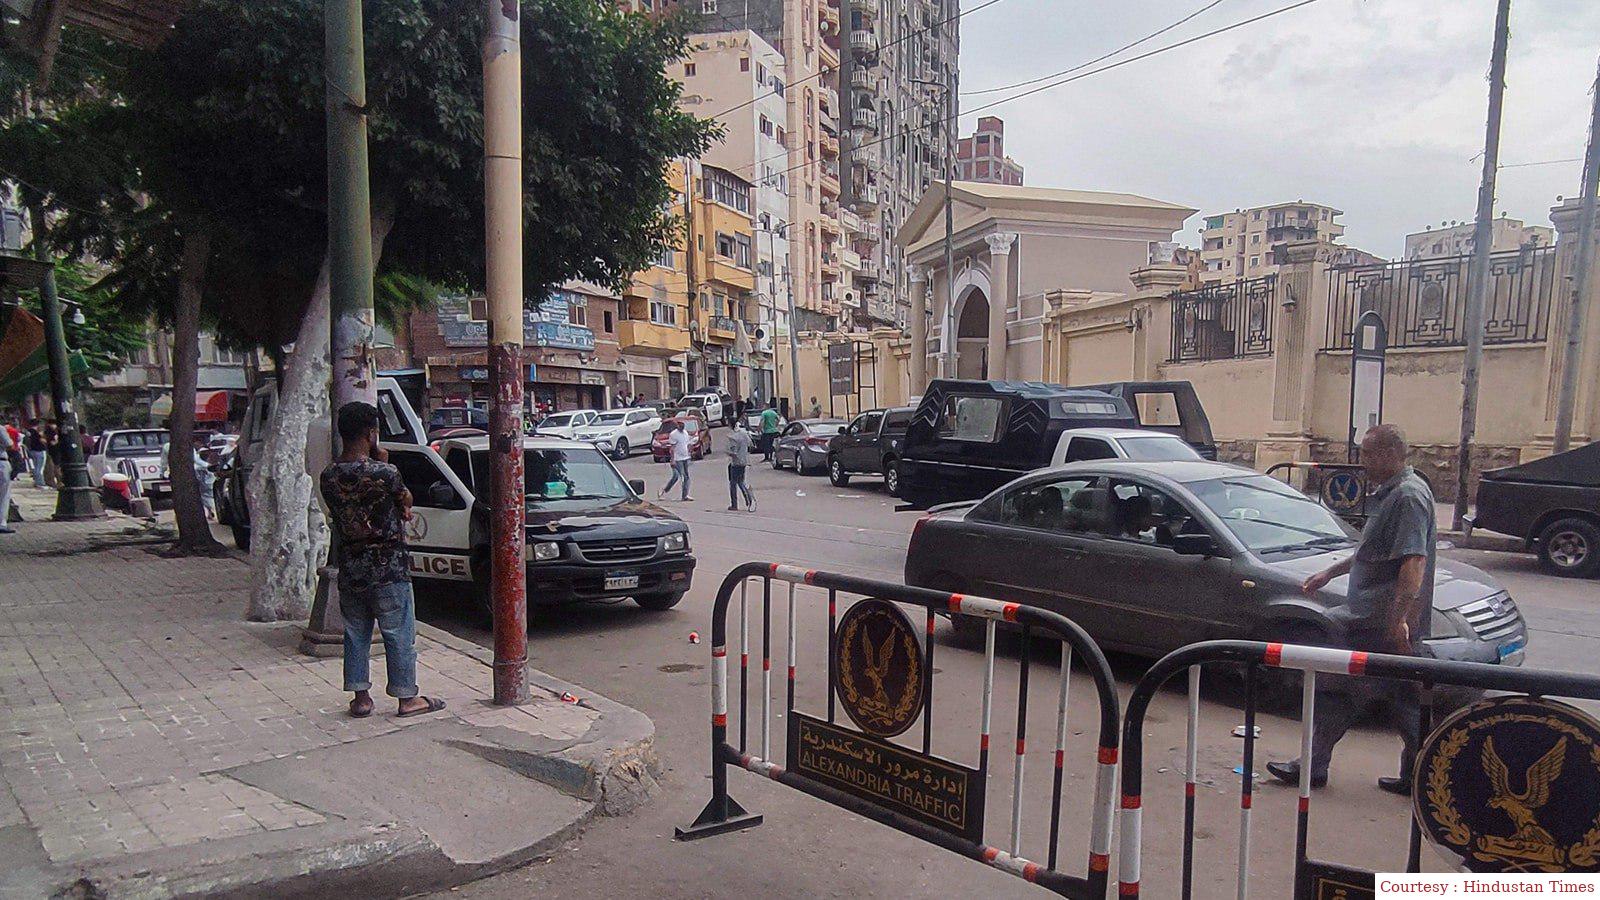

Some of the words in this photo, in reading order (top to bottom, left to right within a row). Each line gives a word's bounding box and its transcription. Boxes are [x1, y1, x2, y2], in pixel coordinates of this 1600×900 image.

[409, 555, 468, 576] LICE
[883, 762, 920, 781] مرور
[802, 750, 891, 796] ALEXANDRIA
[895, 783, 960, 821] TRAFFIC
